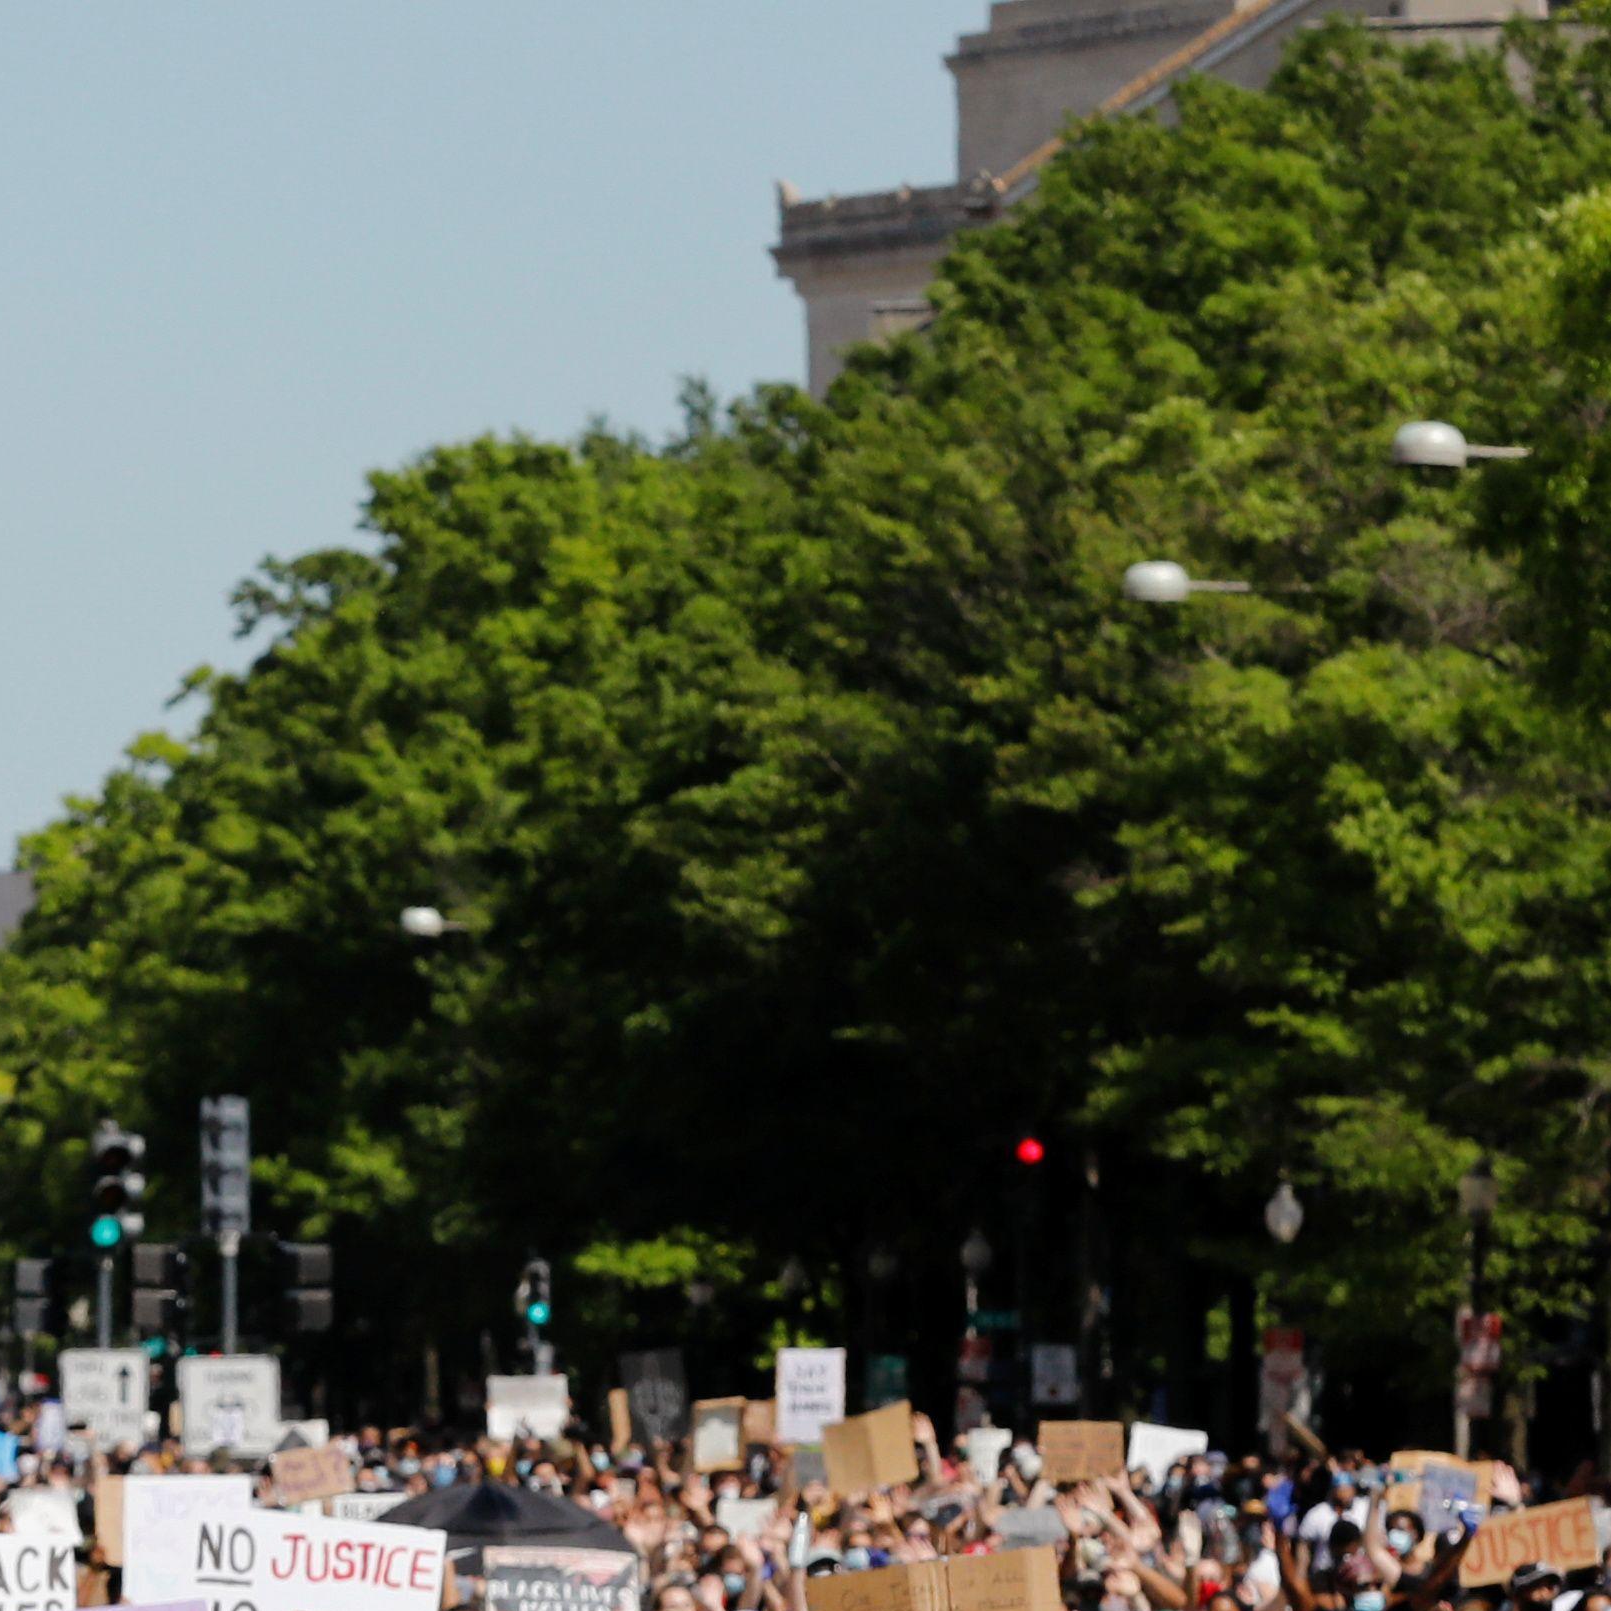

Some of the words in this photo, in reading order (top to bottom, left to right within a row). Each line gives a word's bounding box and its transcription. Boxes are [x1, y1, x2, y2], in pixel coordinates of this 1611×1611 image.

[197, 1521, 256, 1574] NO
[271, 1533, 437, 1591] JUSTICE
[1466, 1506, 1596, 1574] JUSTICE
